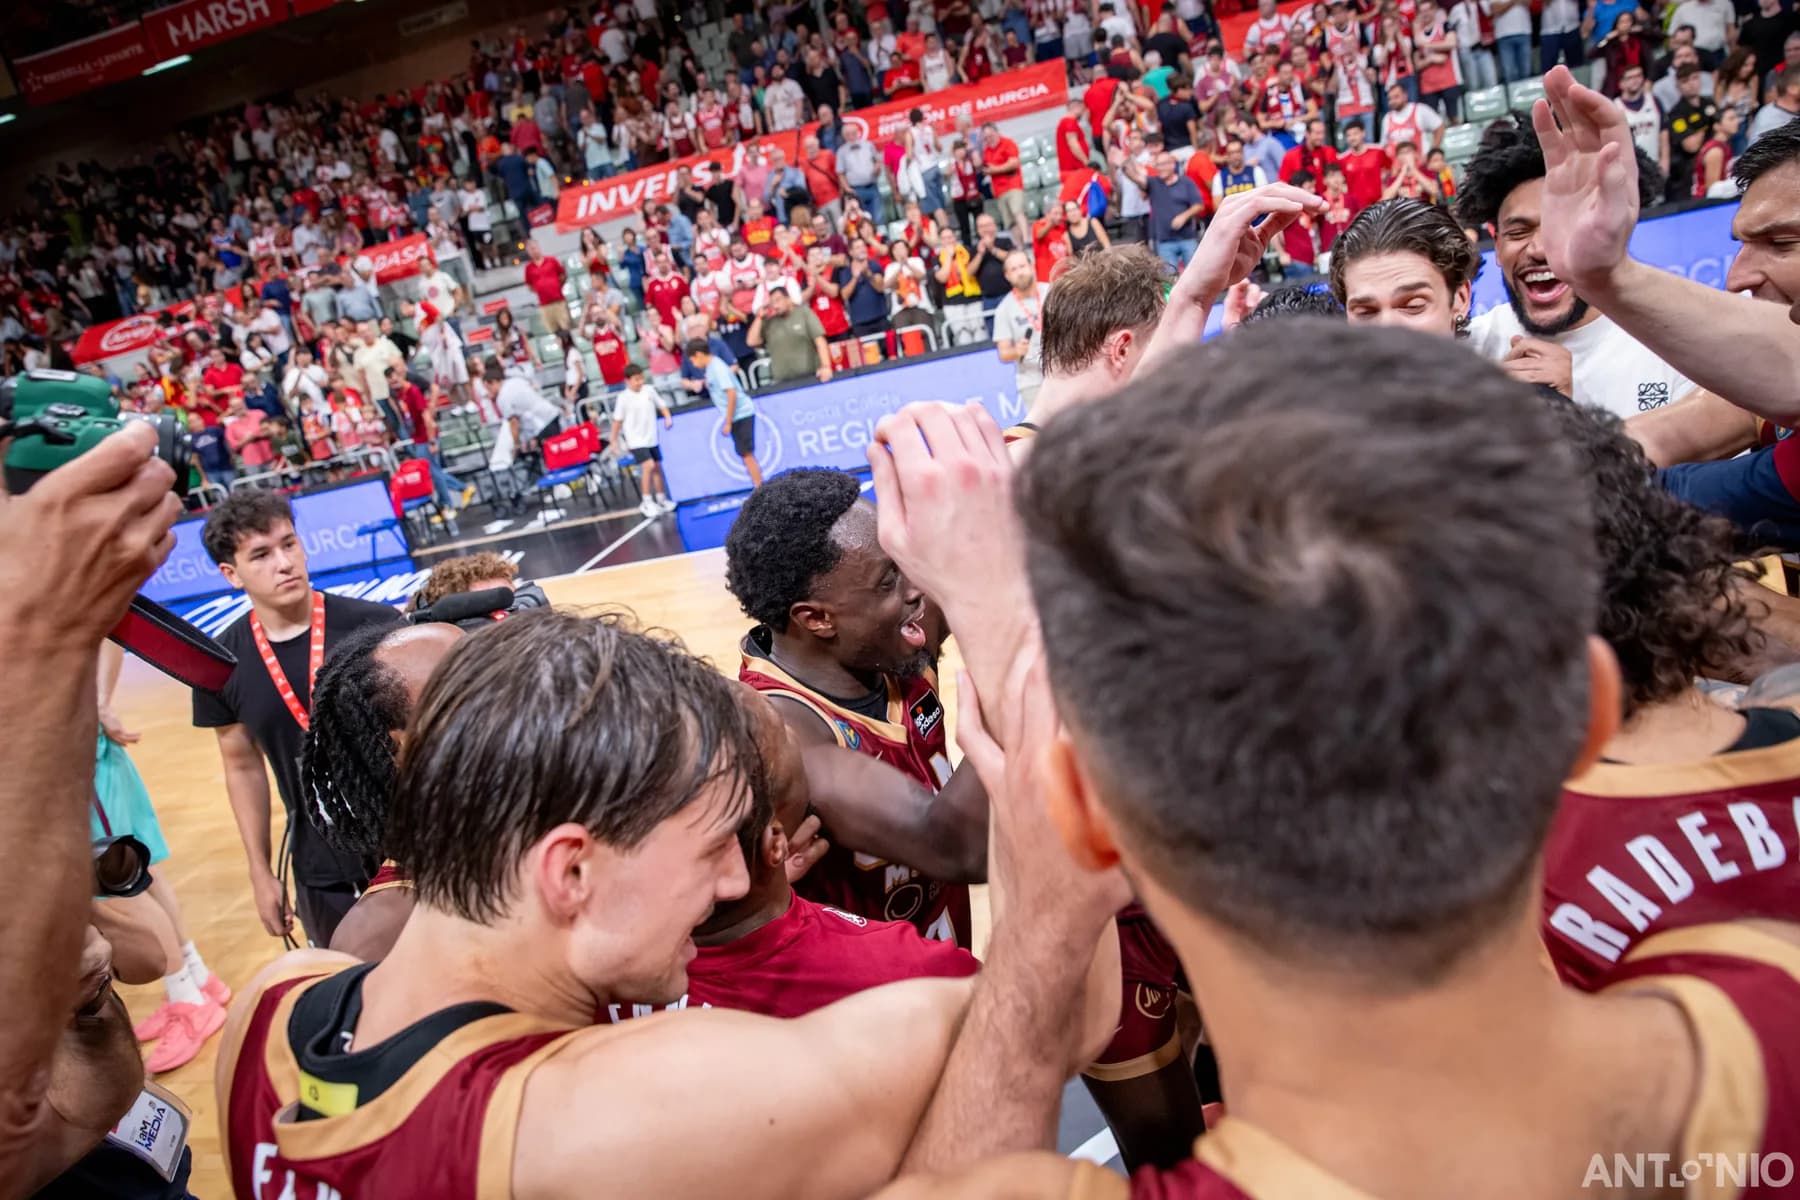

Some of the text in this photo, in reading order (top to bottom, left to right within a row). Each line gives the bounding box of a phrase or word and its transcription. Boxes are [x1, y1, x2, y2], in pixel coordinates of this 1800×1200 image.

[166, 0, 271, 47] MARSH
[948, 101, 972, 118] DE
[976, 83, 1048, 112] MURCIA
[797, 417, 875, 458] REGI
[144, 1107, 166, 1152] MEDIA
